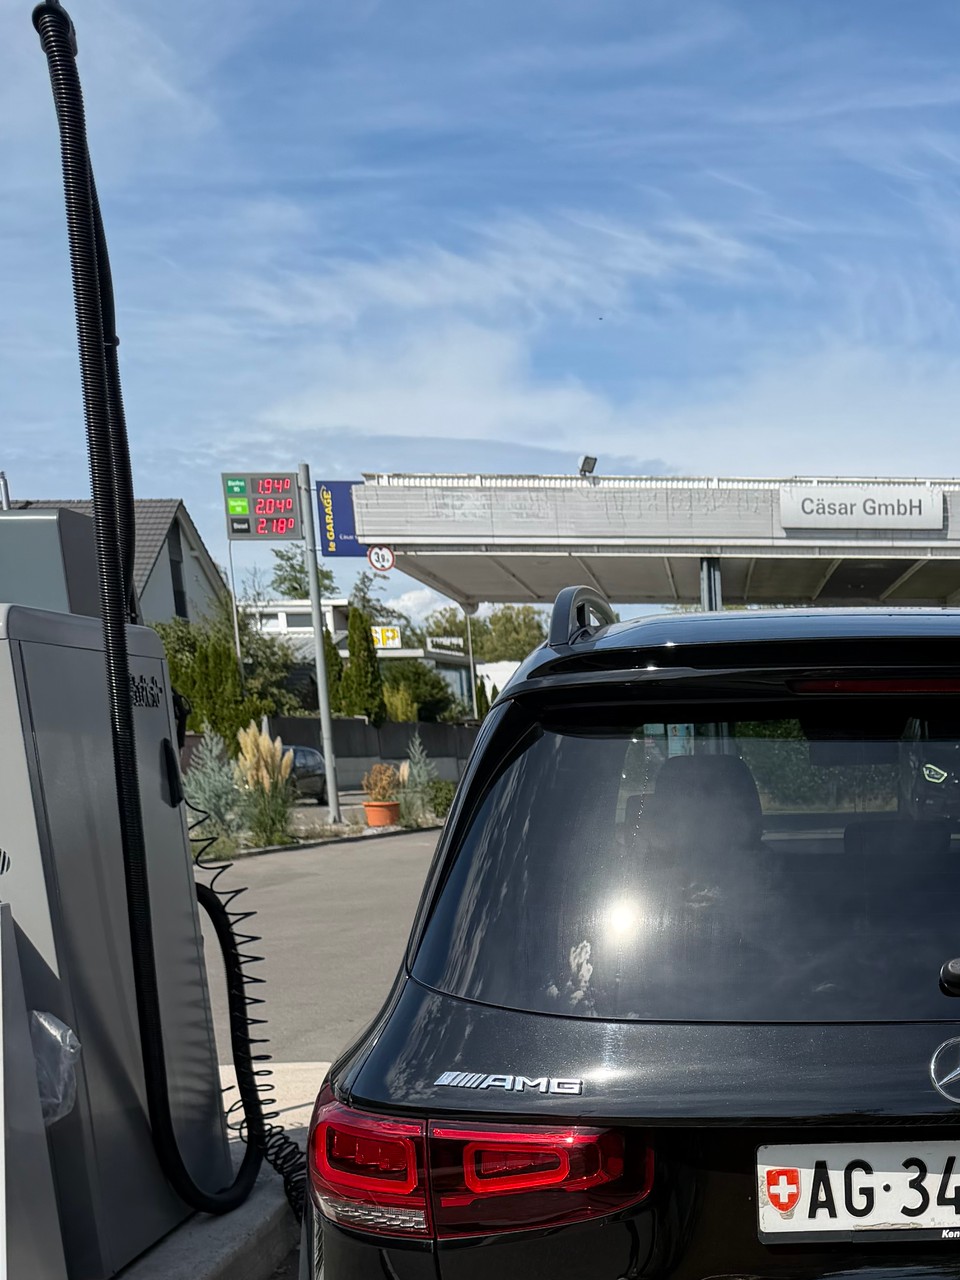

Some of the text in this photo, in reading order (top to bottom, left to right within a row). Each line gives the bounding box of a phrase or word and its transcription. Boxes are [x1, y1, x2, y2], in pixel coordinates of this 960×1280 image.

[323, 490, 335, 540] GARAGE
[801, 497, 922, 516] Cäsar GmbH
[478, 1073, 583, 1095] AMG
